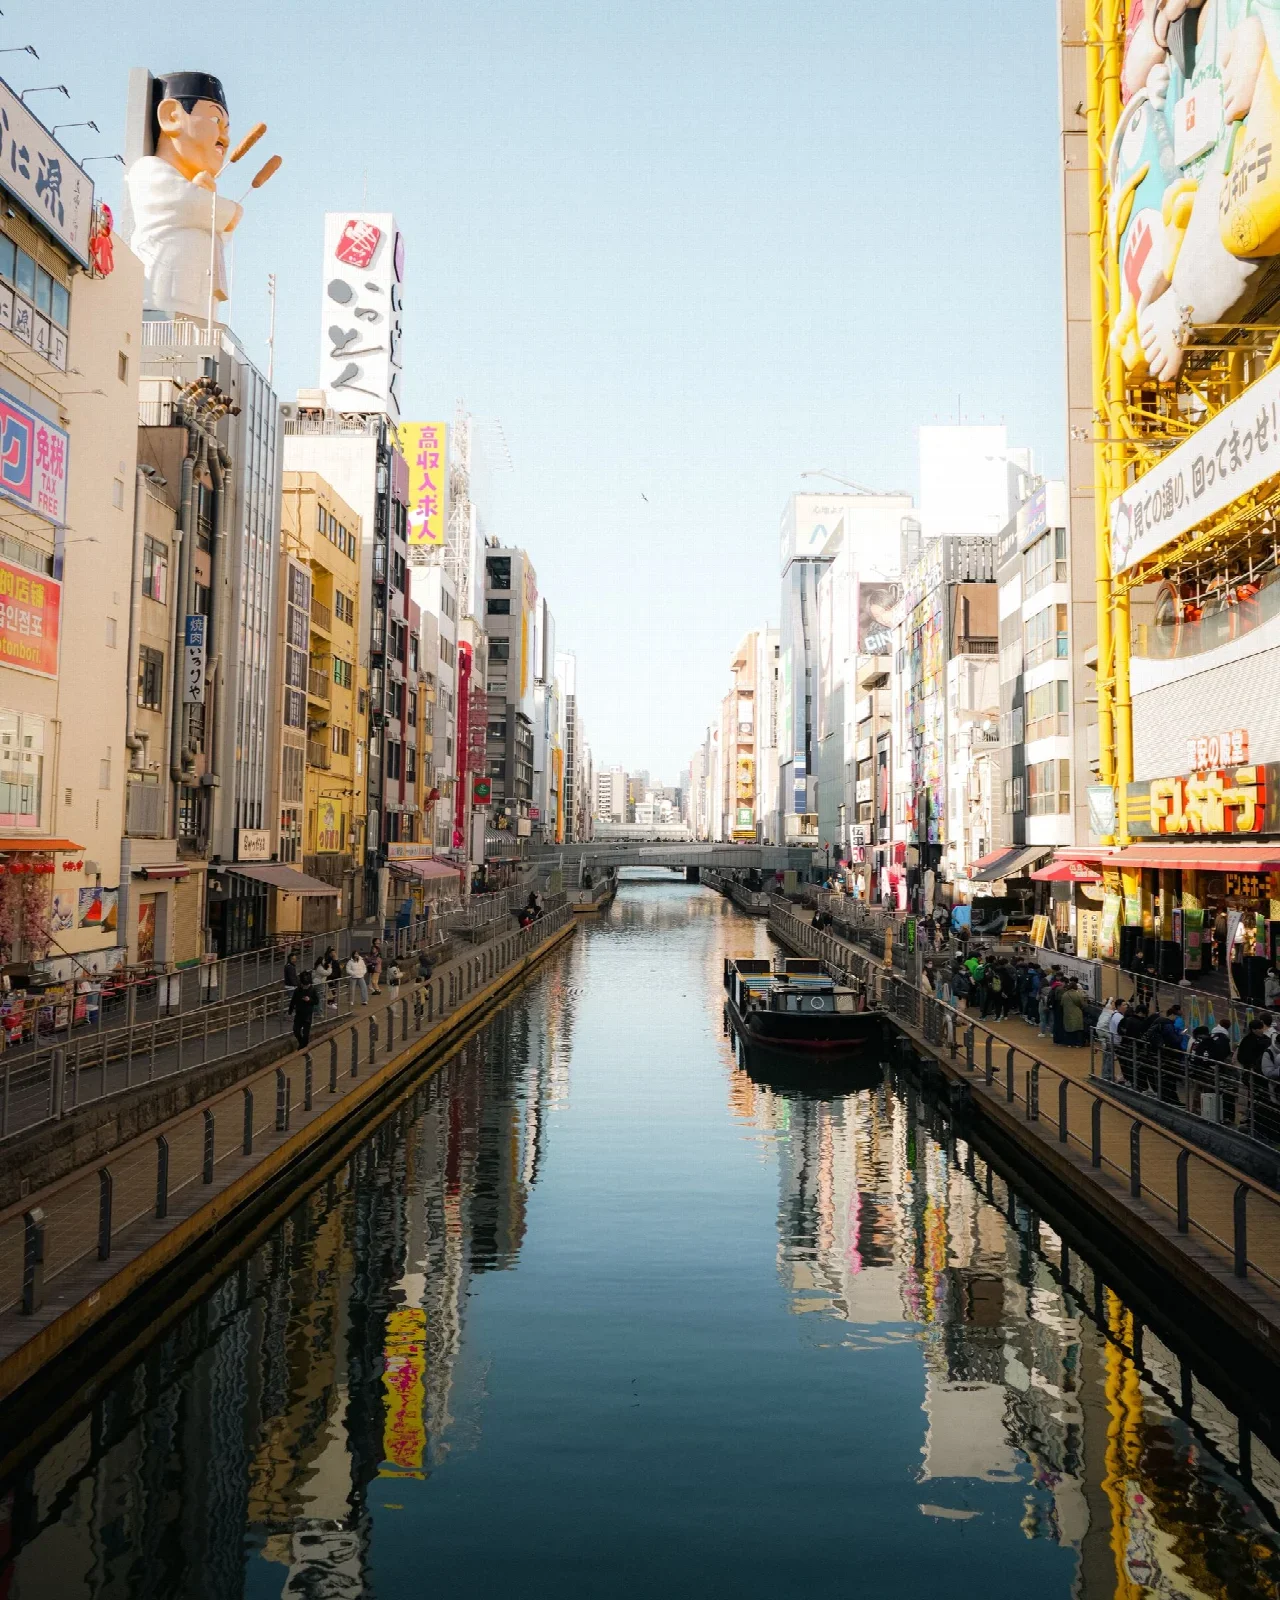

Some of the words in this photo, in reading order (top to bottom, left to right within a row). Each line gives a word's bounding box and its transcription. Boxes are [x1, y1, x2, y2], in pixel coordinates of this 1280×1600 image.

[35, 425, 64, 480] 免税
[1133, 401, 1278, 541] 見ての通り、回ってまっせ!
[38, 491, 58, 516] FREE
[41, 472, 57, 496] TAX
[415, 425, 440, 540] 高収入求人
[189, 617, 203, 645] 焼肉
[188, 647, 201, 700] いろりや
